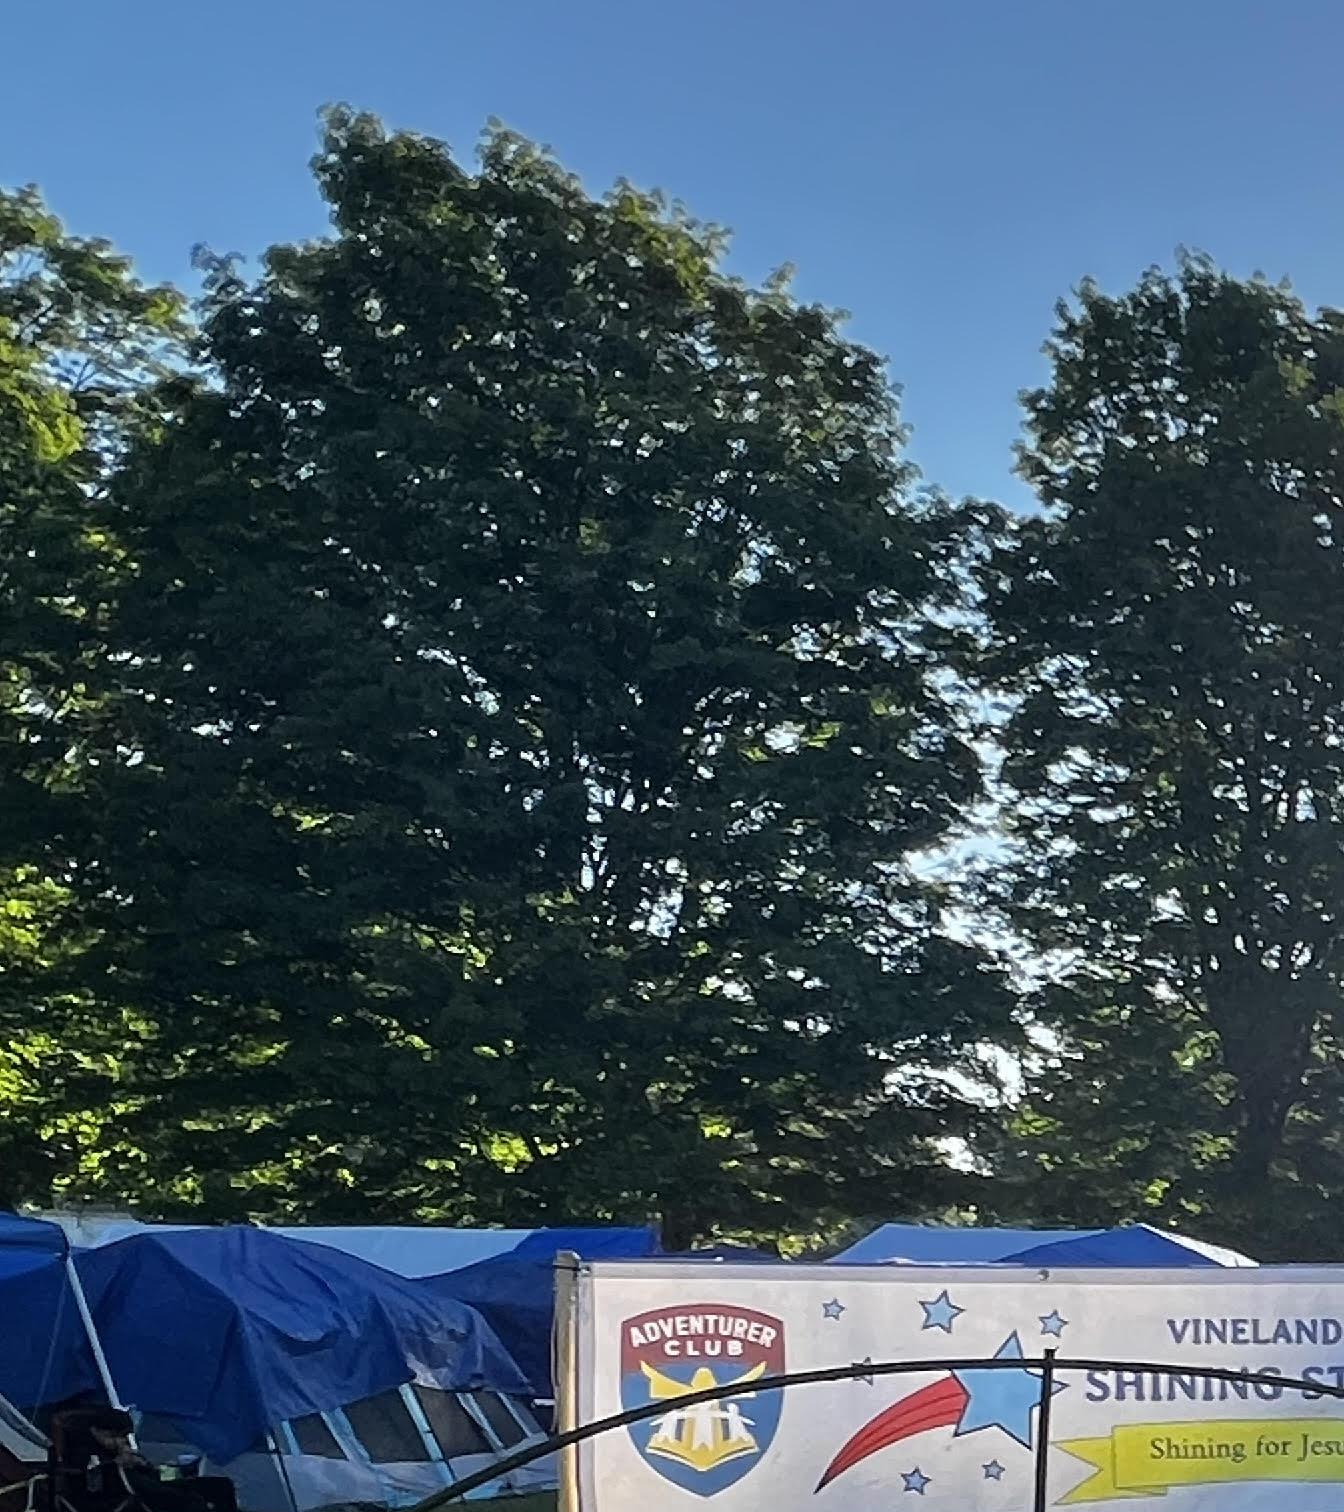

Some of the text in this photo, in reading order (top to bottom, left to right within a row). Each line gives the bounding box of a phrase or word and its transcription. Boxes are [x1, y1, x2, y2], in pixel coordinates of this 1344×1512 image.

[630, 1314, 776, 1348] ADVENTURER
[1167, 1318, 1343, 1345] VINELAND
[664, 1340, 743, 1356] CLUB
[1085, 1366, 1283, 1402] SHINING
[1149, 1438, 1247, 1463] Shining
[1256, 1437, 1291, 1456] for
